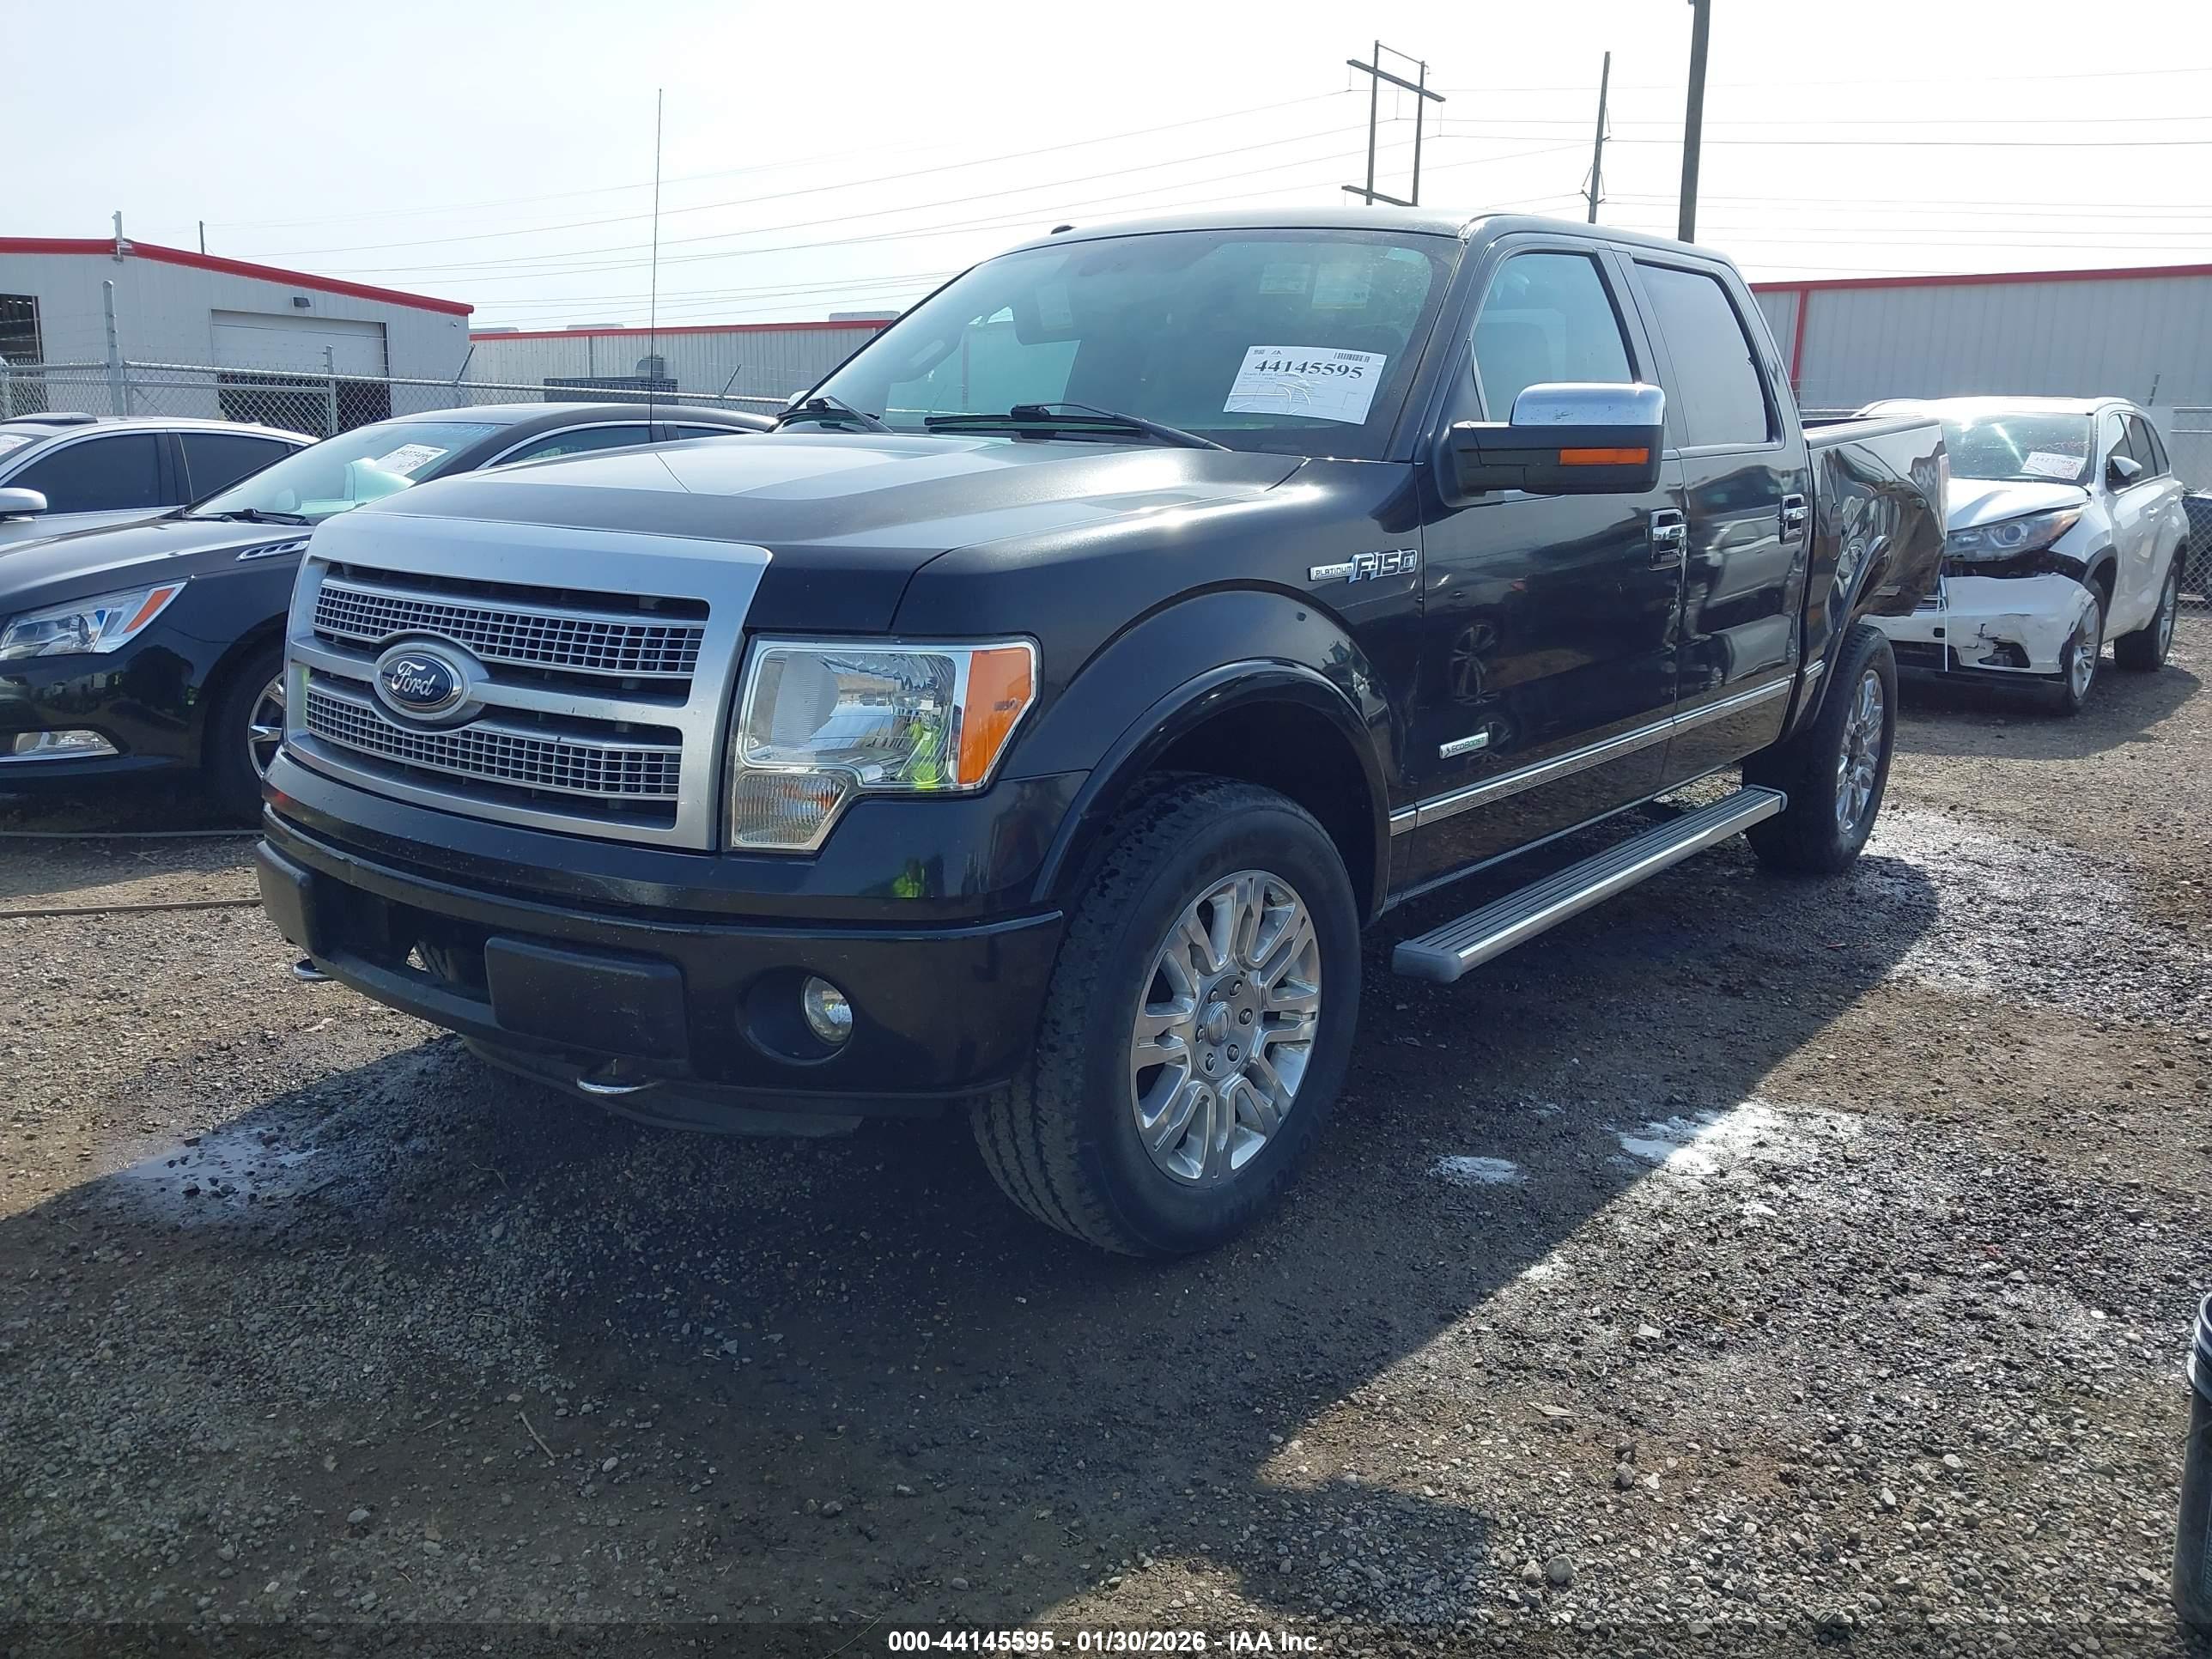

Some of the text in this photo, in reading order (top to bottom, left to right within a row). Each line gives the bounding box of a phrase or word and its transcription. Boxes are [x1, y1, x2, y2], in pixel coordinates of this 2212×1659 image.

[1254, 358, 1364, 380] 44145595
[1315, 565, 1352, 576] PLATINUM
[391, 660, 436, 696] Ford
